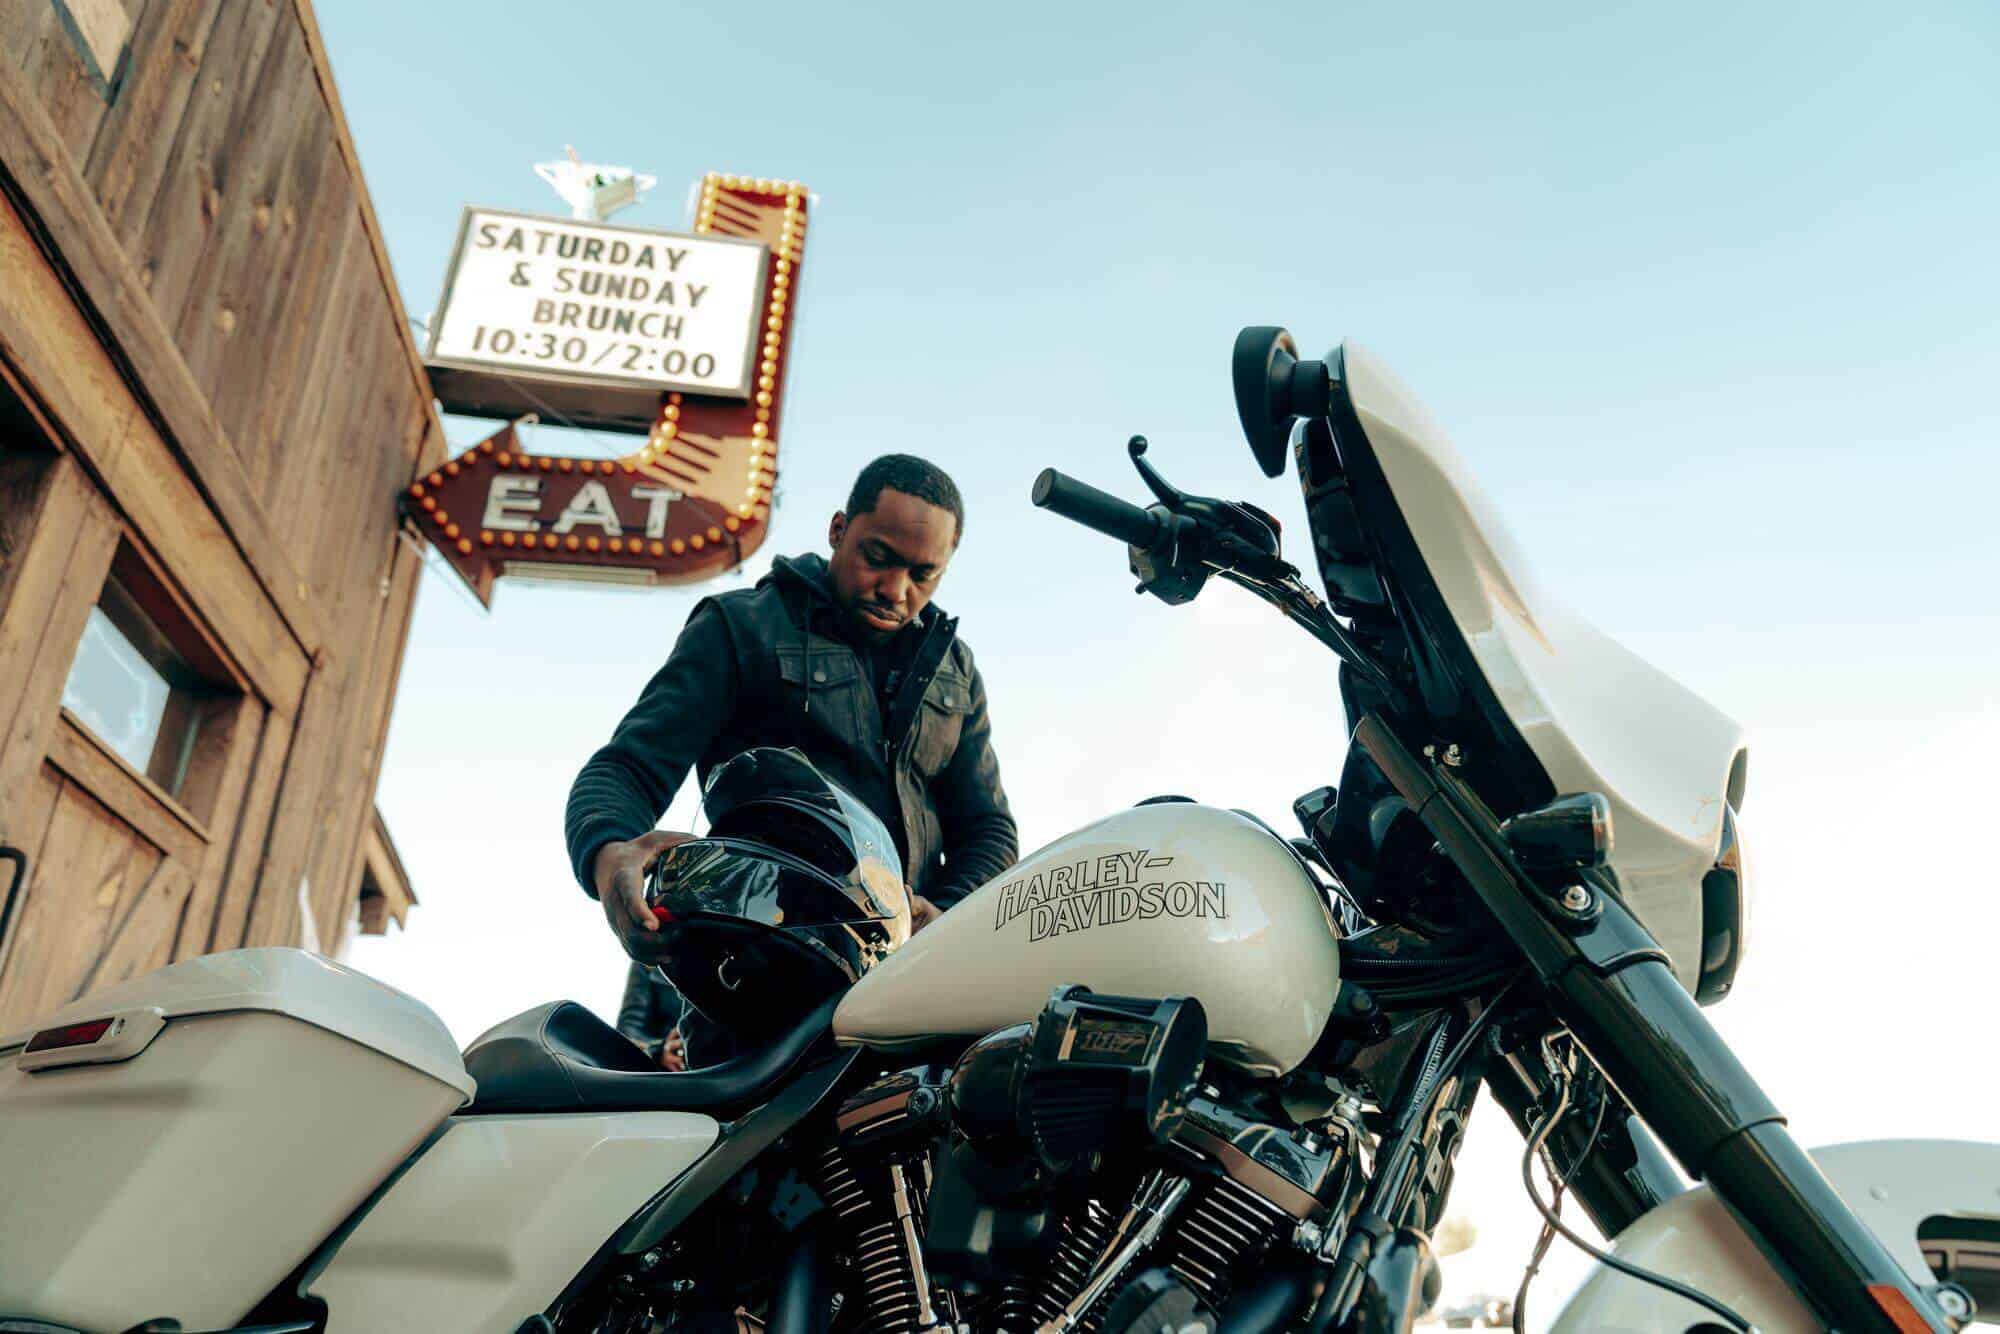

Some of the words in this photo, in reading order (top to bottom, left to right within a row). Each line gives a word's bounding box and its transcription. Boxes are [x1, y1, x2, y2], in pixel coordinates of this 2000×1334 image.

[477, 223, 688, 272] SATURDAY
[509, 262, 531, 287] &
[553, 267, 708, 308] SUNDAY
[532, 298, 684, 340] BRUNCH
[471, 325, 716, 378] 10:30/2:00
[481, 474, 683, 539] EAT
[1030, 881, 1227, 942] DAVIDSON
